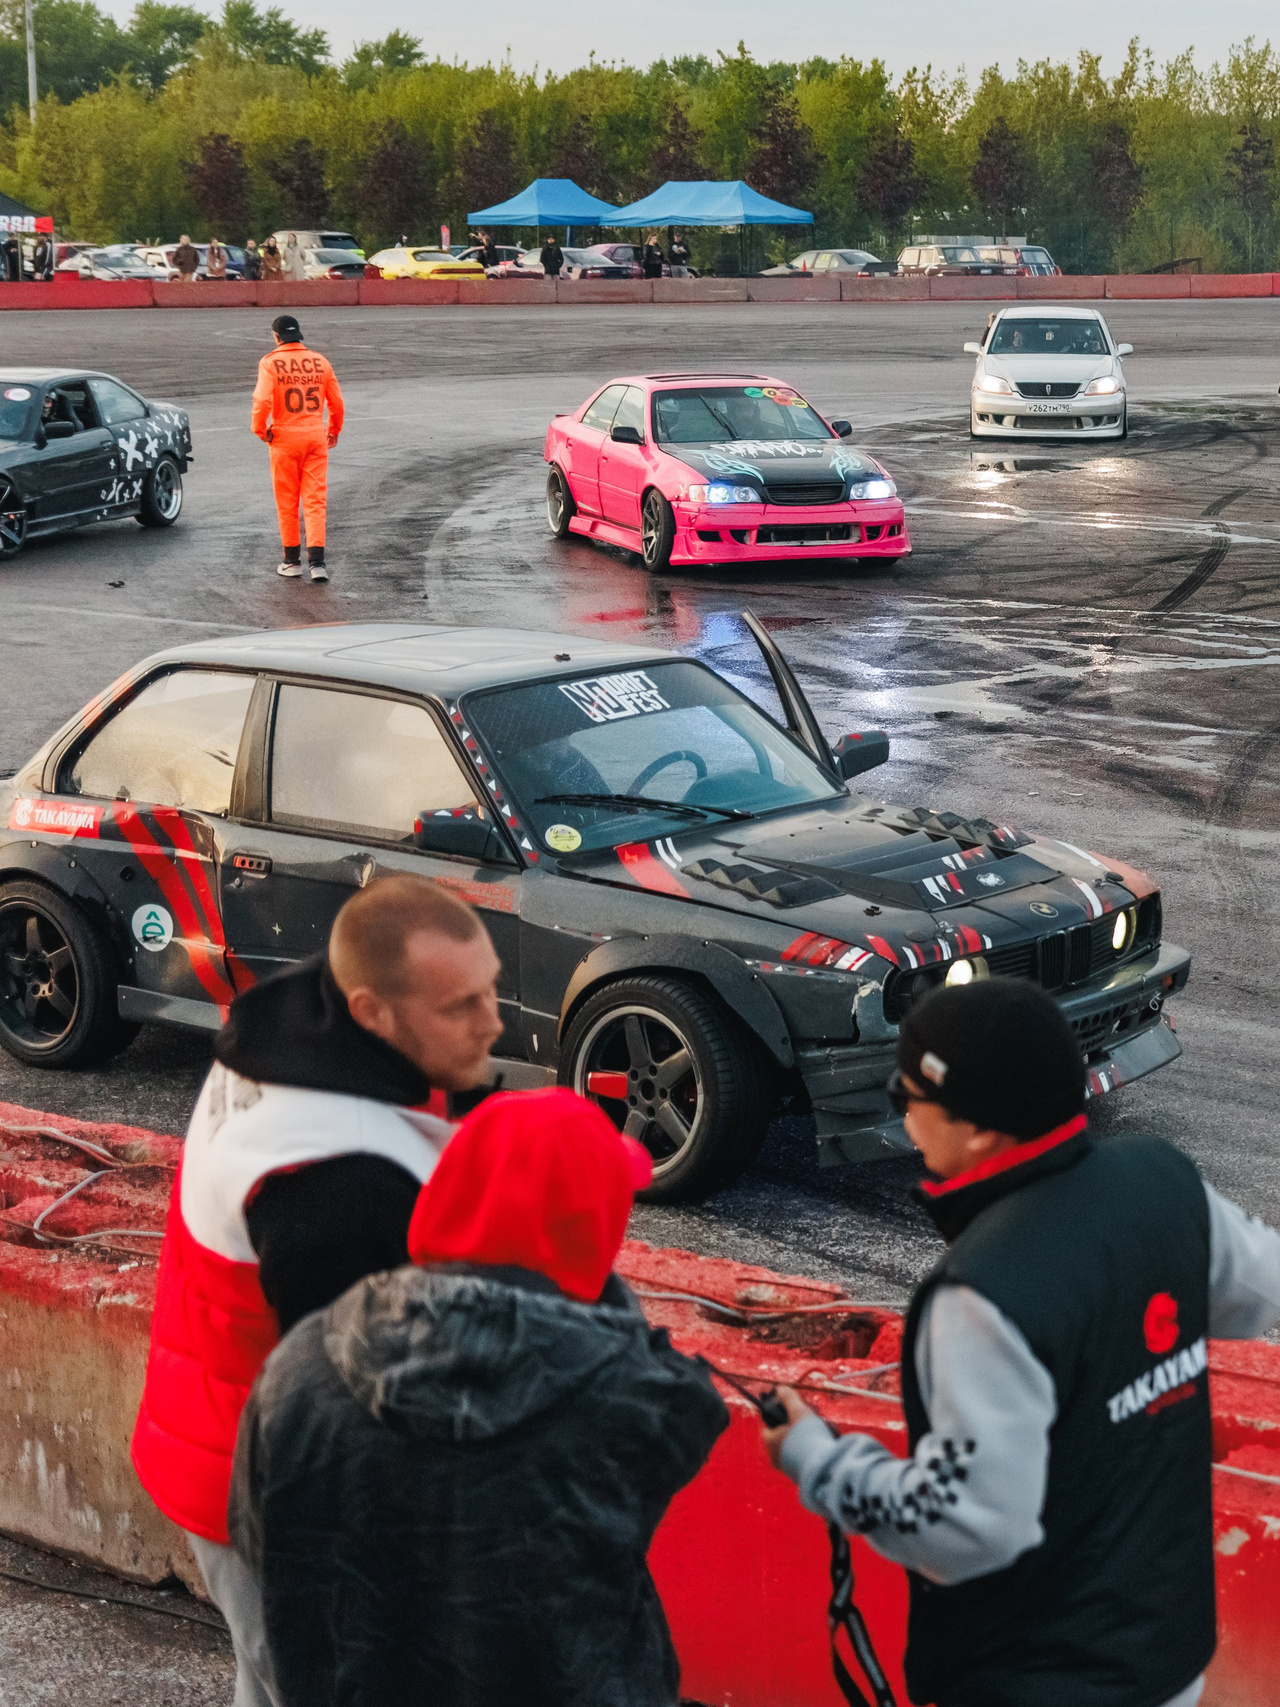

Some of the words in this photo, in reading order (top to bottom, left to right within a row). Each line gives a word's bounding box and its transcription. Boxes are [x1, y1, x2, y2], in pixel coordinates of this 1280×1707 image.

[273, 358, 324, 374] RACE
[277, 375, 323, 385] MARSHAL
[284, 387, 320, 413] 05
[600, 670, 658, 696] DRIFT
[619, 689, 671, 714] FEST
[34, 808, 95, 829] TAKAYAMA
